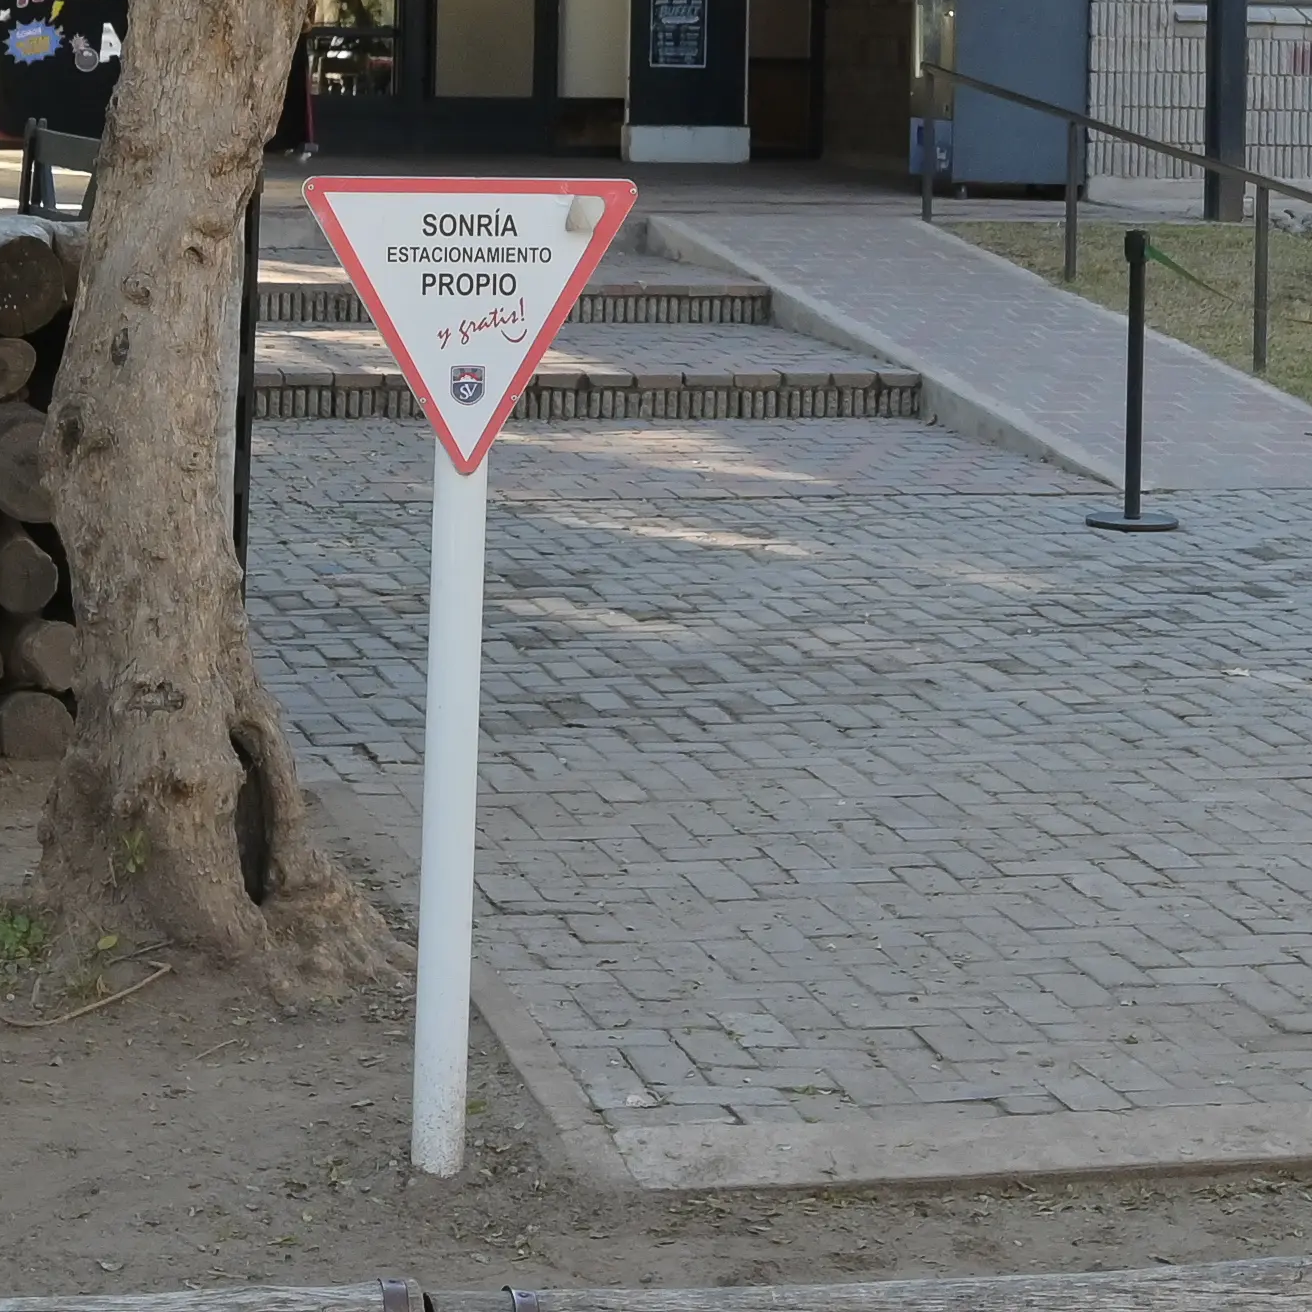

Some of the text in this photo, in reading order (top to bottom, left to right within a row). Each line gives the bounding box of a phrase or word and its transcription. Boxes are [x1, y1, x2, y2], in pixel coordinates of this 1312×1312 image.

[421, 208, 518, 237] SONRÍA
[386, 245, 553, 264] ESTACIONAMIENTO
[421, 272, 517, 296] PROPIO
[437, 297, 526, 349] y gratis!
[459, 383, 478, 399] SV
